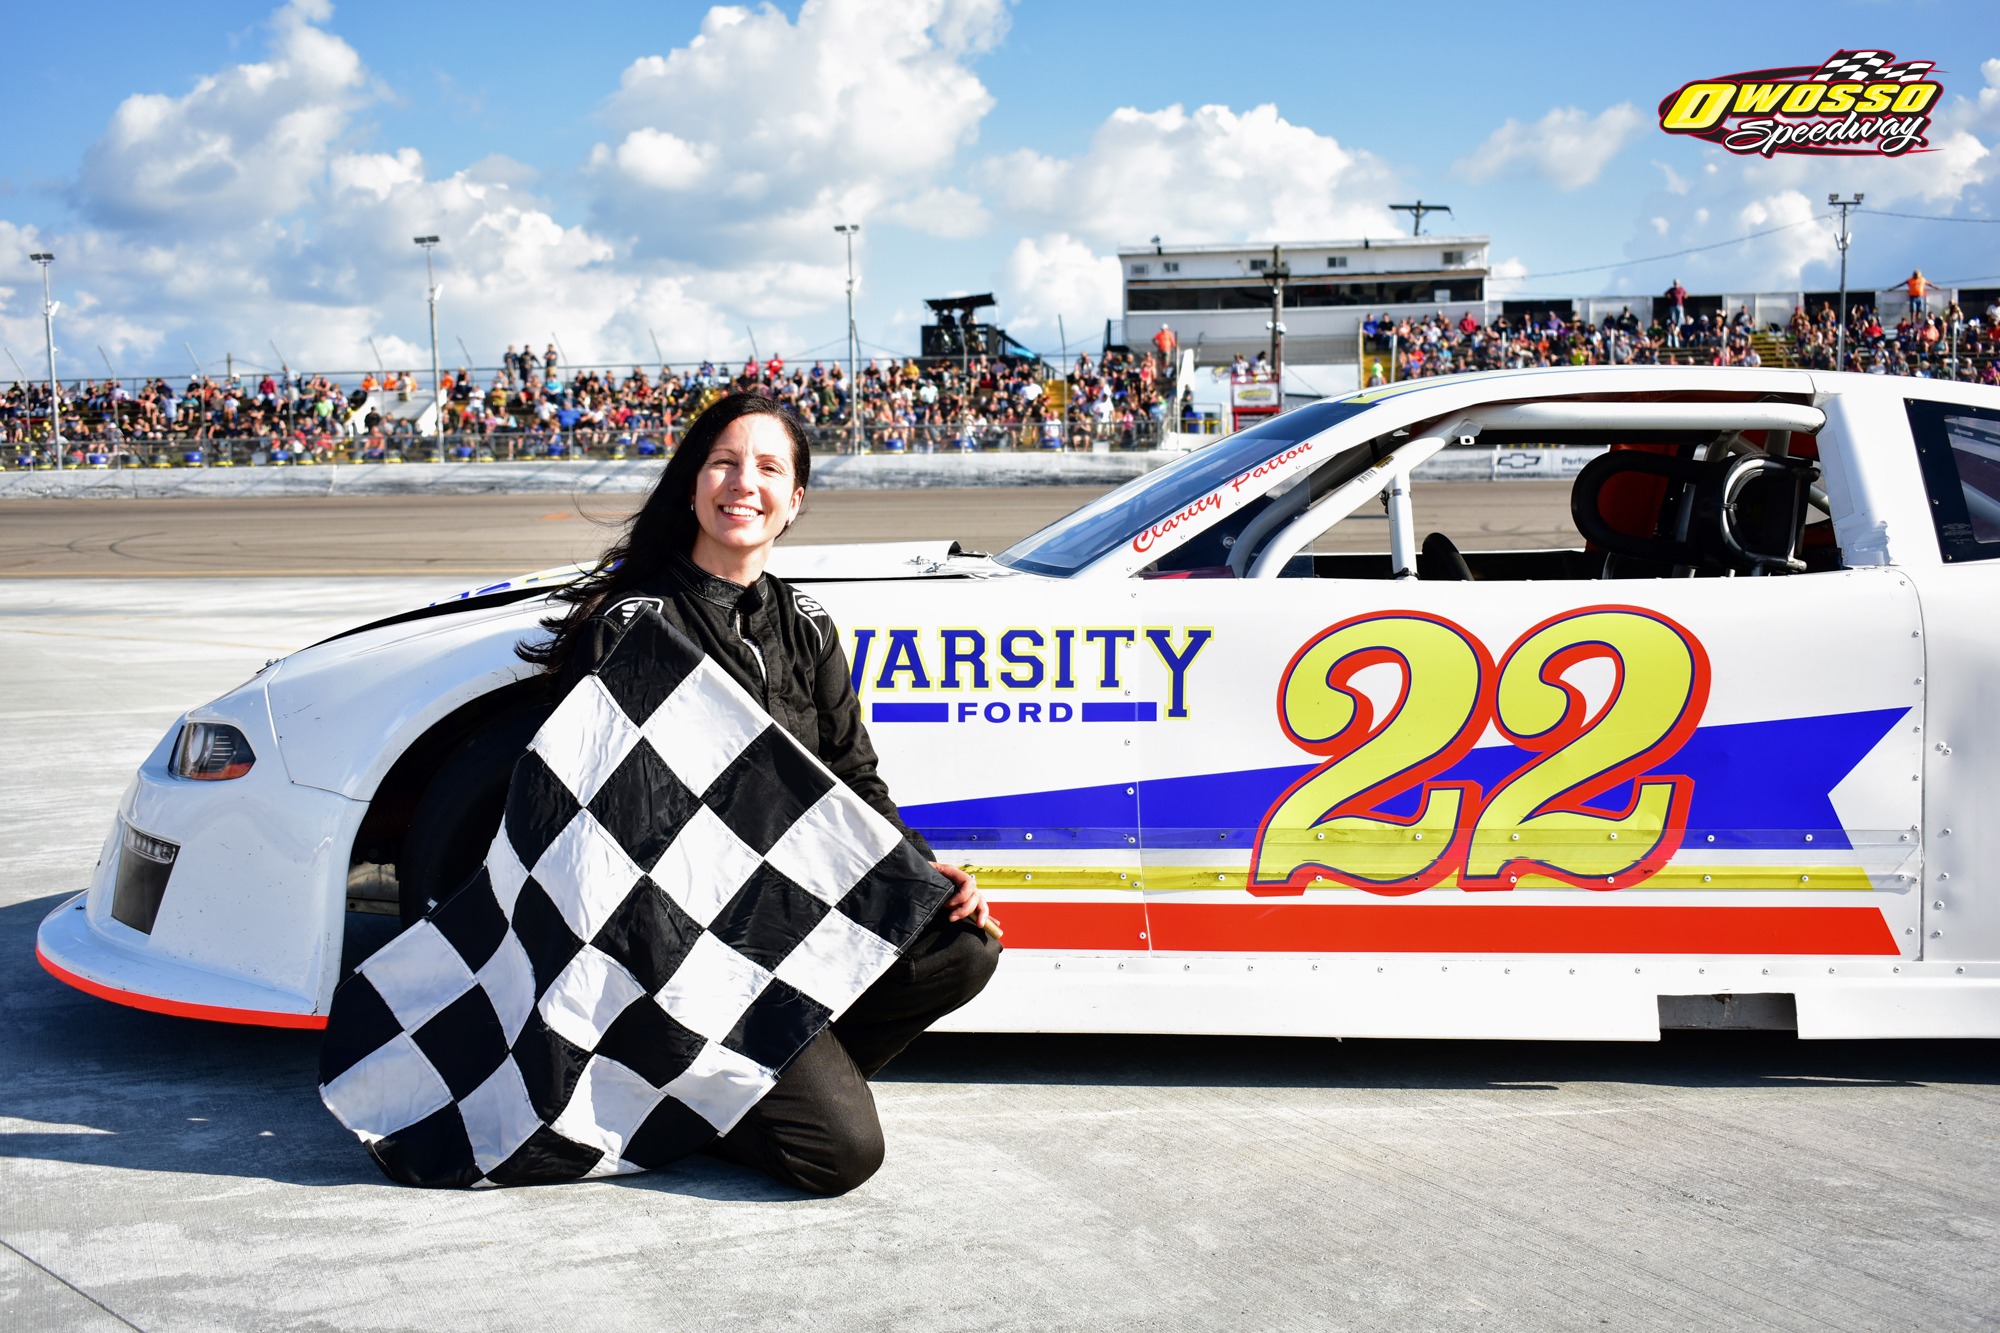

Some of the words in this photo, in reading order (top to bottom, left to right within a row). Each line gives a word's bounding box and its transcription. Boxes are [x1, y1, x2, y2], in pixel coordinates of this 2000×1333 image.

[1132, 493, 1222, 553] Clarity
[1224, 442, 1313, 492] Patton
[957, 701, 1074, 724] FORD
[1246, 604, 1712, 897] 22
